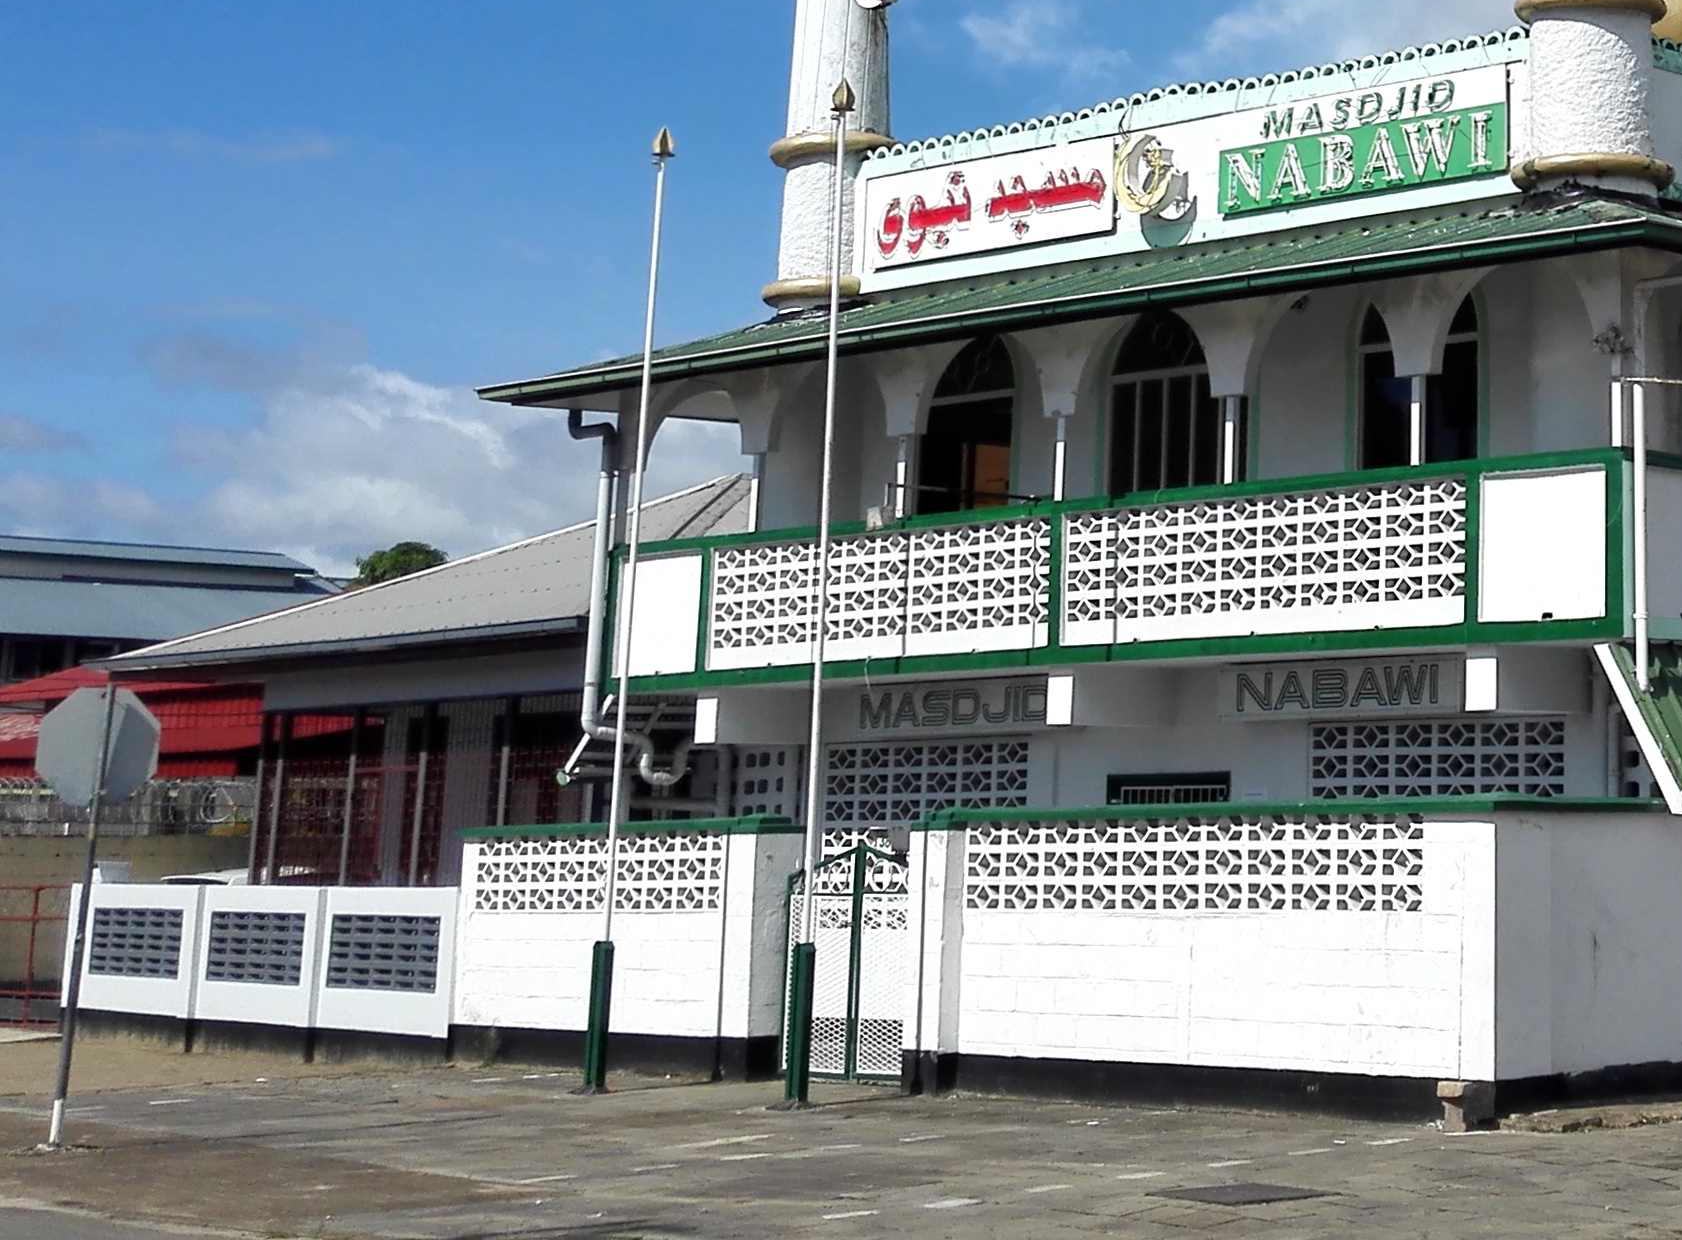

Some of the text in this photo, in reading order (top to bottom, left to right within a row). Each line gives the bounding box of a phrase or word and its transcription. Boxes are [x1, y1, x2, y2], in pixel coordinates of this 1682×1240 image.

[1259, 78, 1456, 140] MASDJID
[1223, 110, 1493, 210] NABAWI
[859, 663, 1440, 730] MASDJID NABAWI
